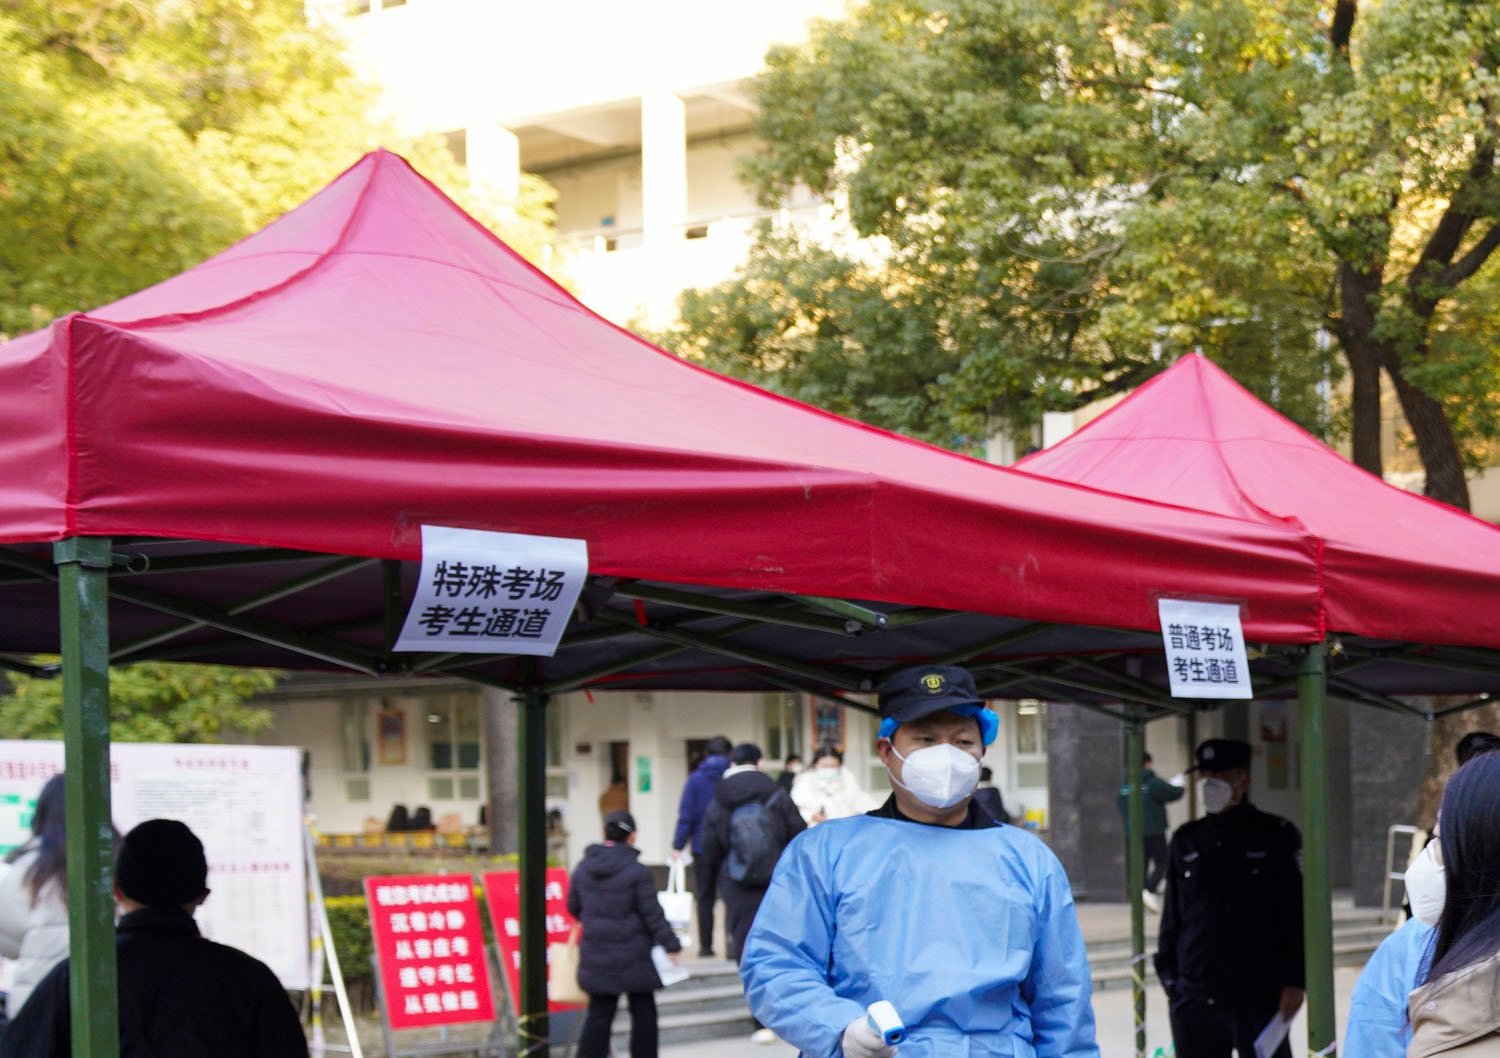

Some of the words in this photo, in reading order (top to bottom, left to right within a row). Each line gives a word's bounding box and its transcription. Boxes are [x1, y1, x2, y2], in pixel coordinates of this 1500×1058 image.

[432, 559, 566, 601] 特殊考场
[418, 604, 551, 639] 考生通道
[1168, 623, 1234, 652] 普通考场
[1173, 655, 1239, 684] 考生通道
[395, 936, 469, 960] 从容应考
